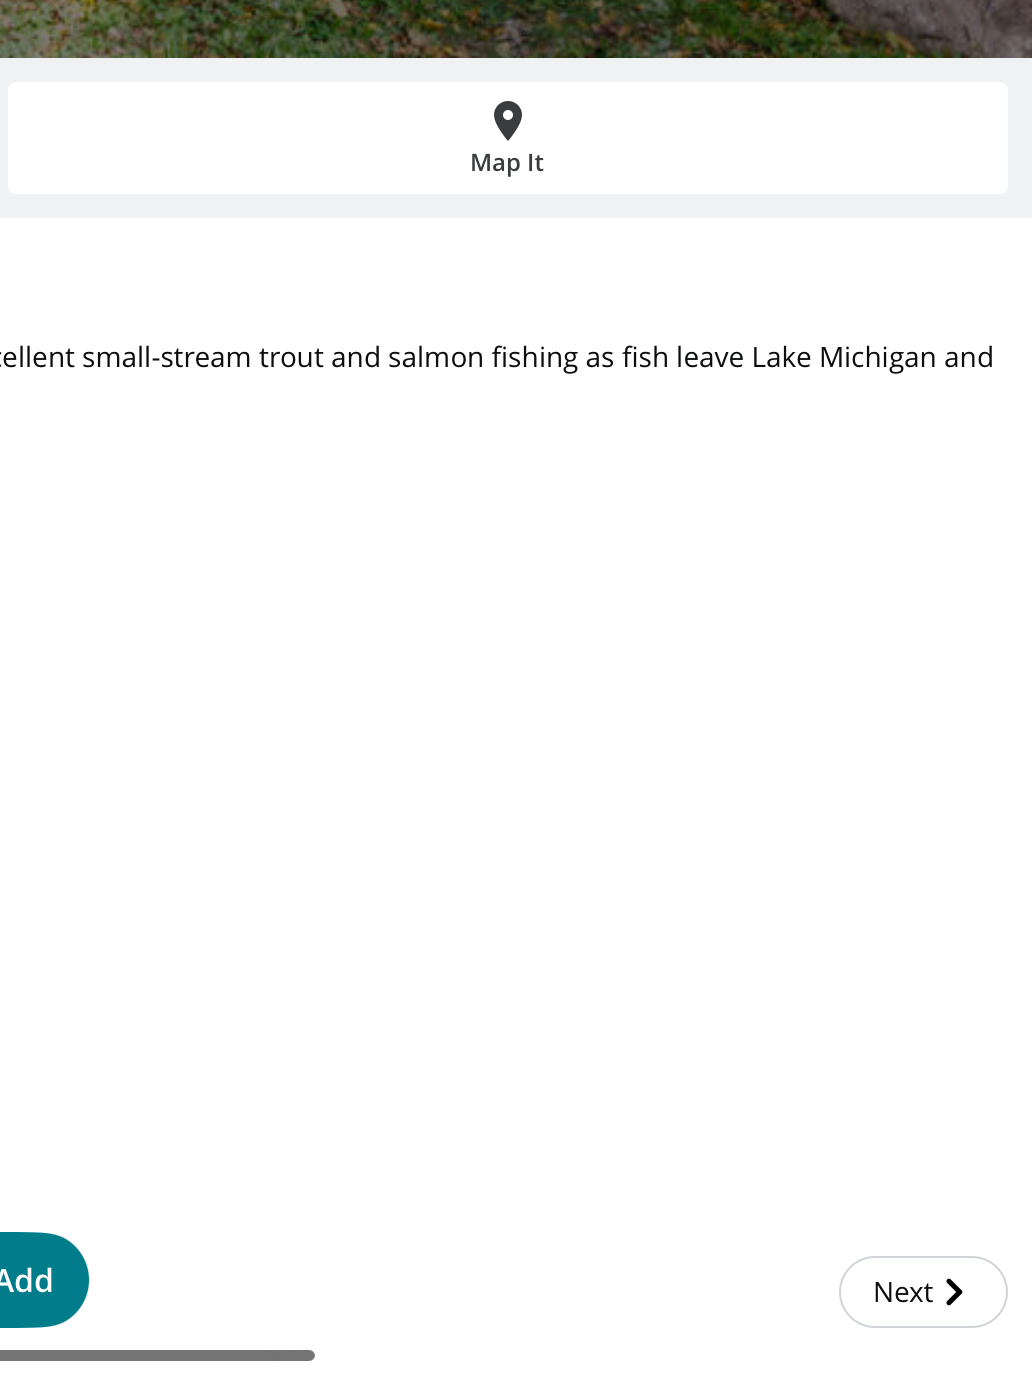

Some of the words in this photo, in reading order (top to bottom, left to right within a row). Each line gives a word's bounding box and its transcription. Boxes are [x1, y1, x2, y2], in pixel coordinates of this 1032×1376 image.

[471, 153, 521, 178] Map
[528, 153, 545, 172] It
[82, 344, 251, 368] small-stream
[258, 347, 325, 368] trout
[331, 344, 380, 368] and
[388, 344, 483, 368] salmon
[491, 344, 579, 375] fishing
[586, 351, 614, 368] as
[621, 344, 668, 368] fish
[677, 344, 744, 368] leave
[753, 344, 811, 368] Lake
[820, 344, 936, 375] Michigan
[944, 344, 993, 368] and
[874, 1281, 934, 1303] Next
